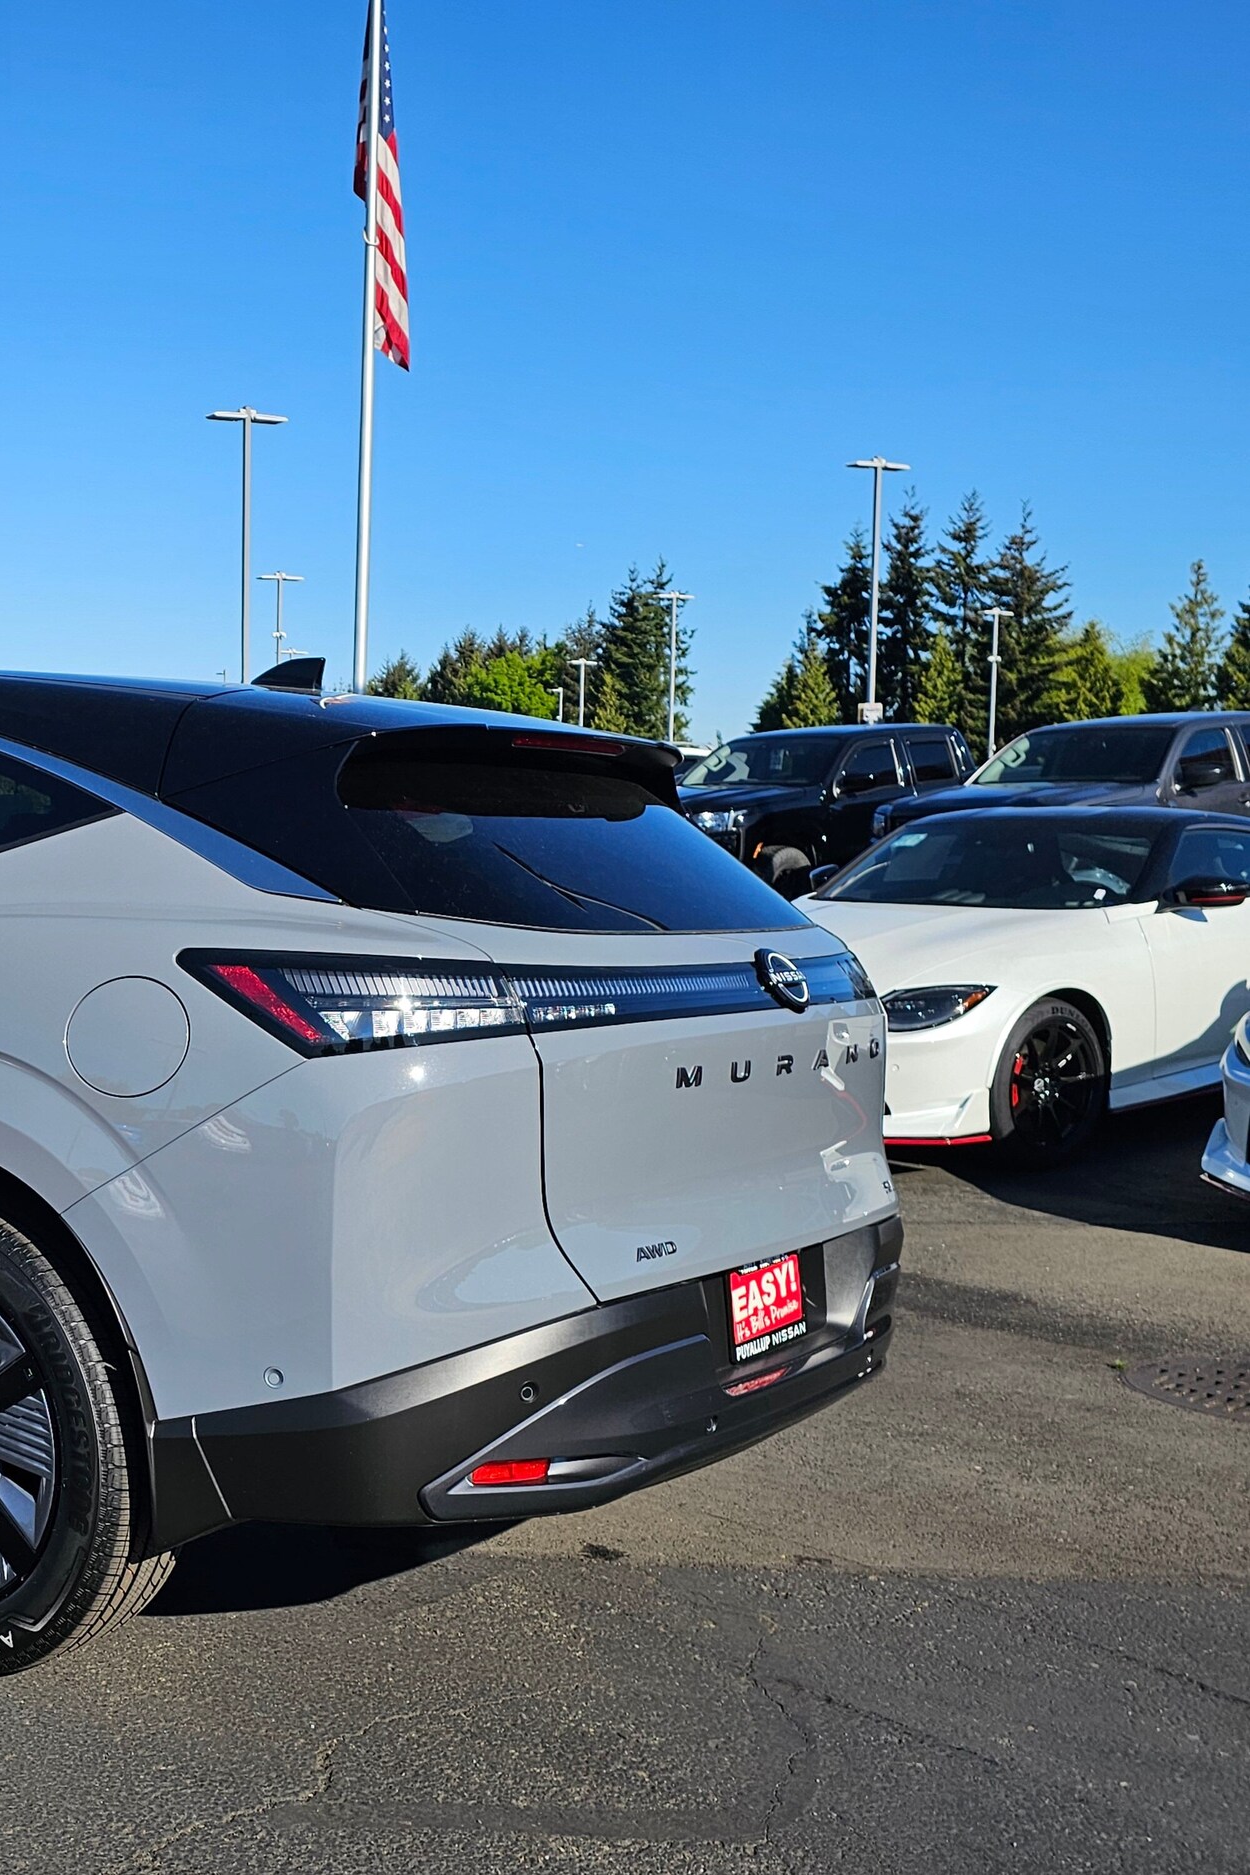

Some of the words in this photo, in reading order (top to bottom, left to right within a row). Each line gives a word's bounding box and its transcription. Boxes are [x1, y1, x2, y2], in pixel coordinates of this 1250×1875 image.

[675, 1037, 881, 1089] MURANO
[636, 1239, 678, 1263] AWD
[731, 1260, 797, 1323] EASY!
[735, 1335, 771, 1362] PUYALLUP
[771, 1321, 807, 1346] NISSAN
[736, 1320, 751, 1342] It's
[750, 1308, 771, 1332] Bill's
[769, 1299, 799, 1323] Promise
